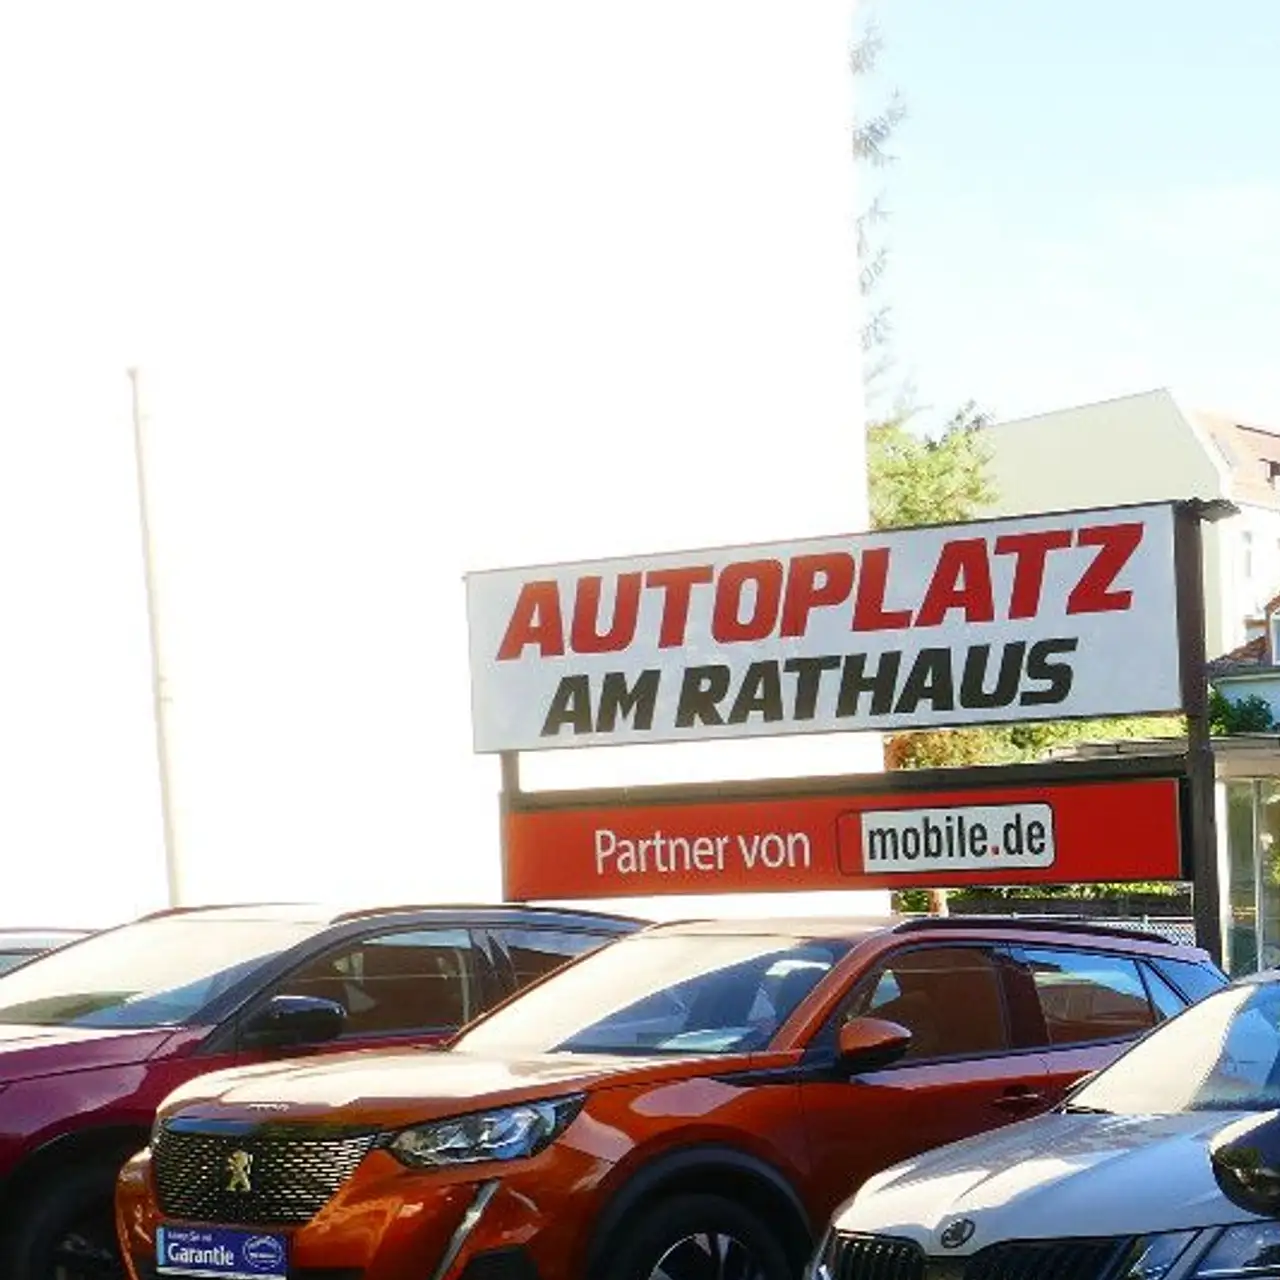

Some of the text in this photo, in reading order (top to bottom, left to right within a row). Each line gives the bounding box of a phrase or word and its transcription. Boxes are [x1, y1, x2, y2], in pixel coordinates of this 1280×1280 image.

[496, 521, 1145, 661] AUTOPLATZ
[540, 637, 1079, 737] AM RATHAUS
[594, 813, 1046, 874] Partner von mobile.de
[167, 1242, 234, 1266] Garantie
